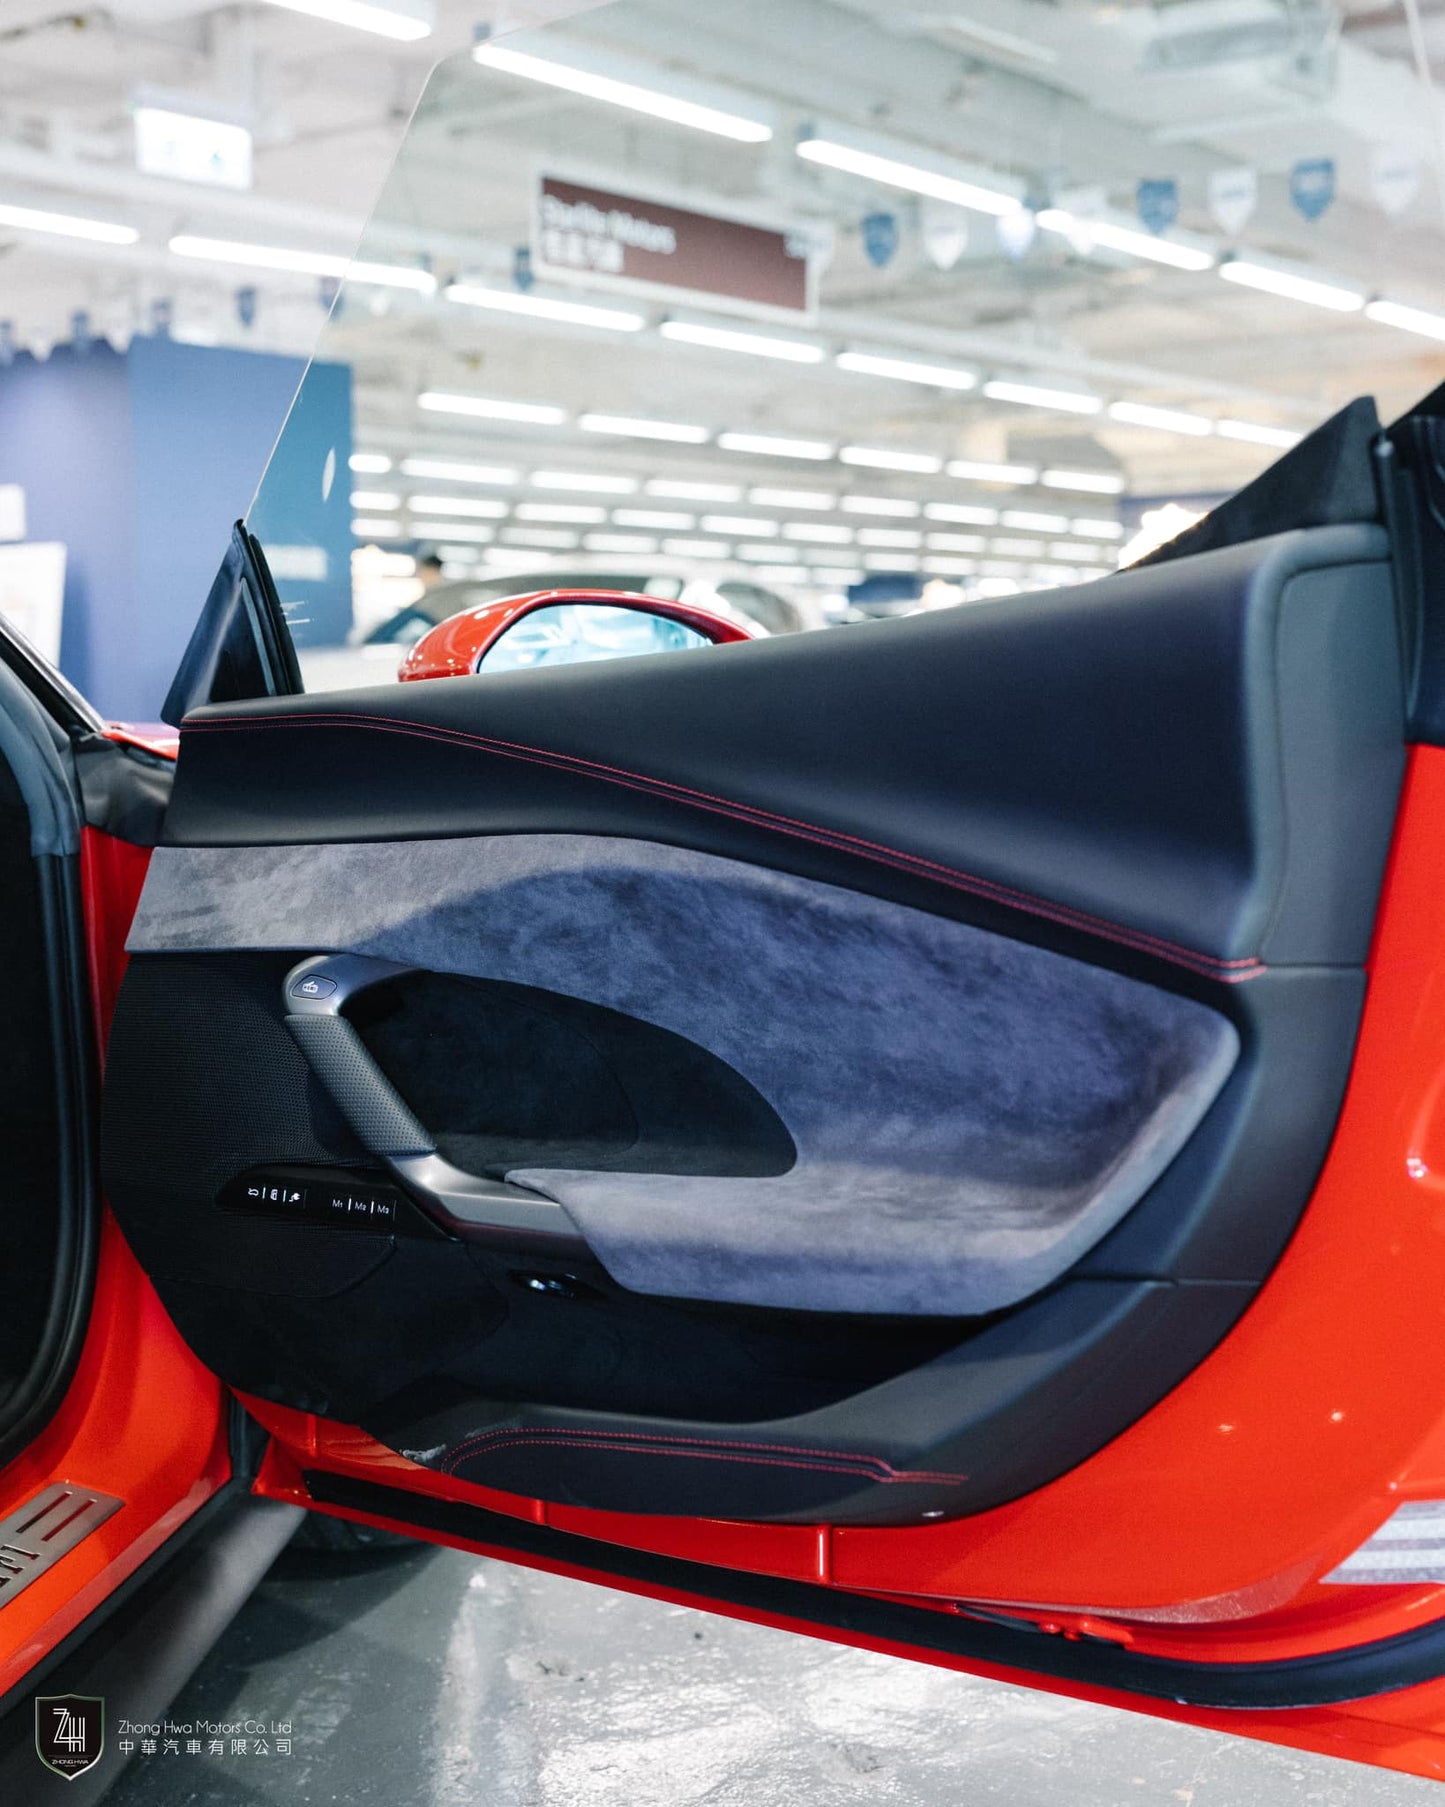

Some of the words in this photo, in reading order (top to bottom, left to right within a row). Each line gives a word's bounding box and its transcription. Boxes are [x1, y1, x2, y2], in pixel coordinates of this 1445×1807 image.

[332, 1199, 343, 1208] M1
[354, 1201, 367, 1211] M2
[377, 1204, 390, 1214] M3
